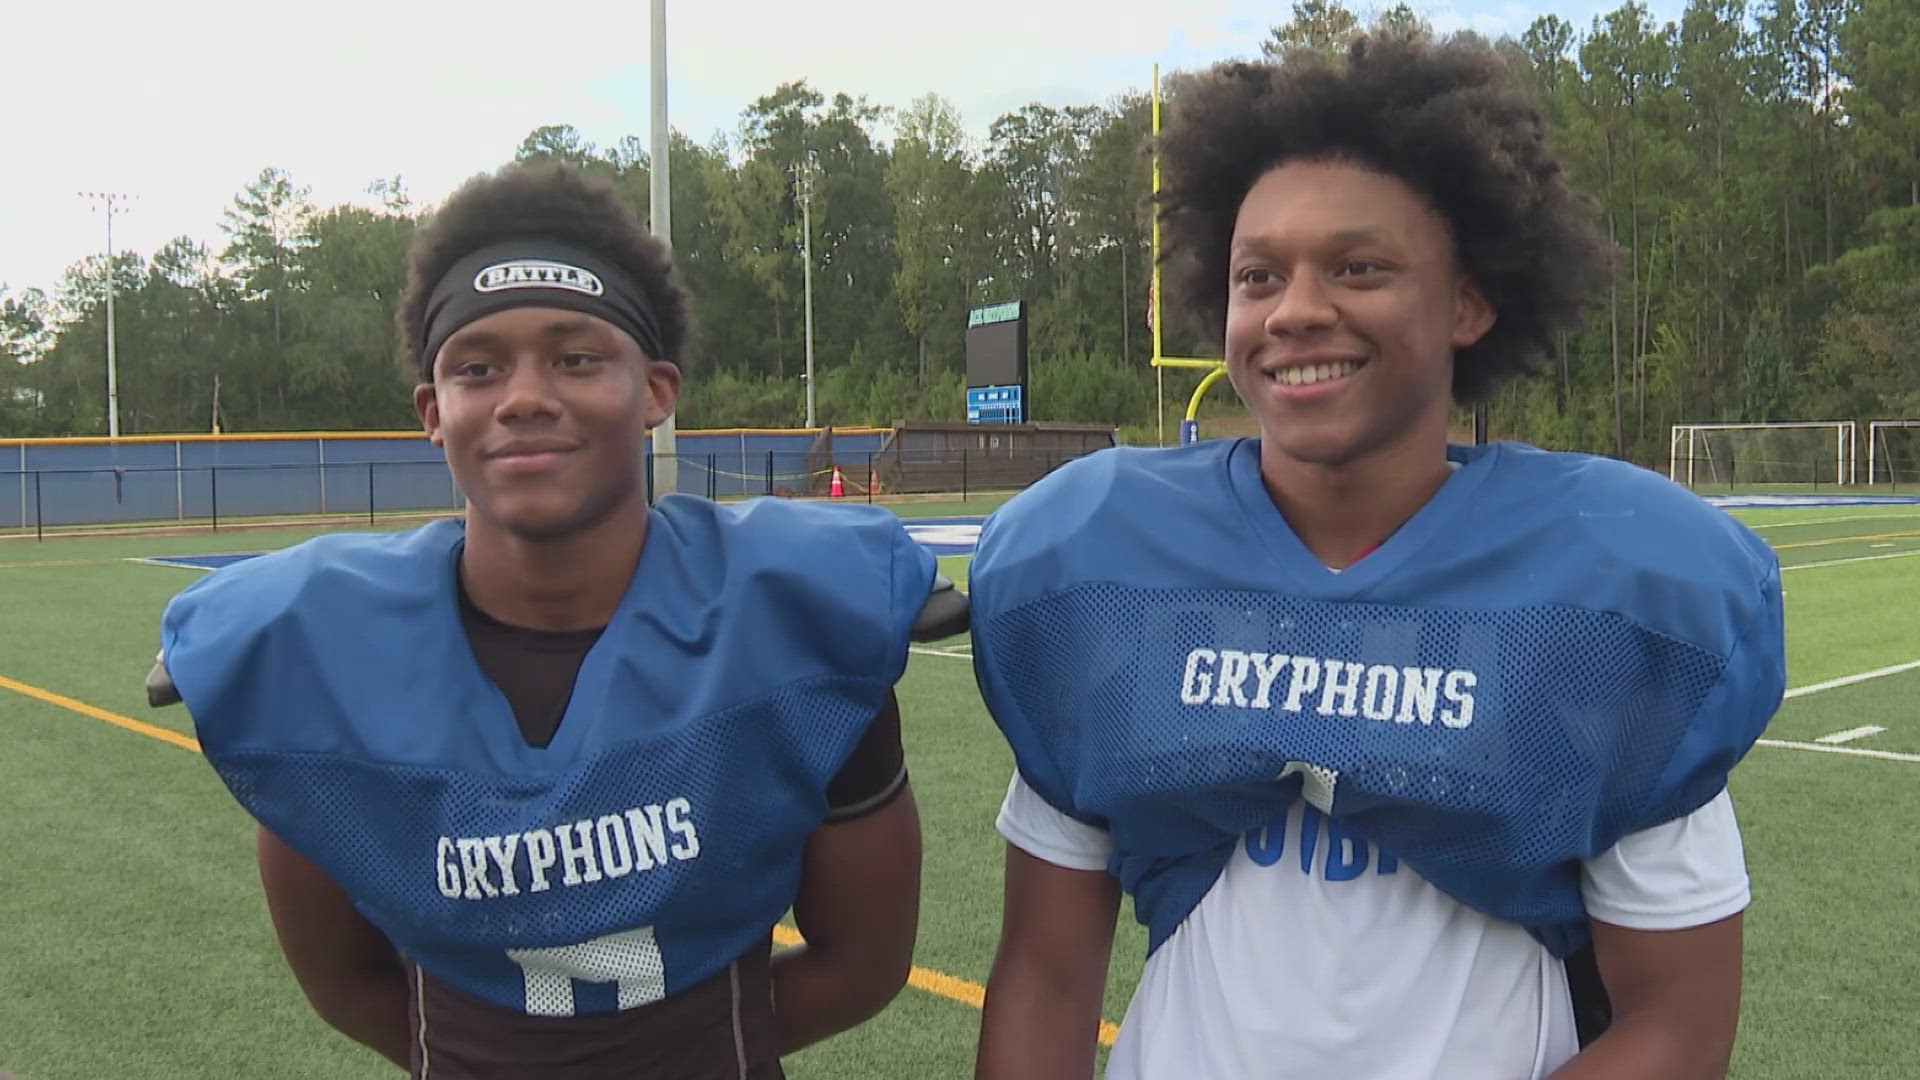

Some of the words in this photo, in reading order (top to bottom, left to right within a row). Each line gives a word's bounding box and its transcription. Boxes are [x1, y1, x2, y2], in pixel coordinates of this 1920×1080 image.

[486, 266, 593, 291] BATTLE
[1181, 648, 1477, 729] GRYPHONS
[436, 797, 700, 900] GRYPHONS
